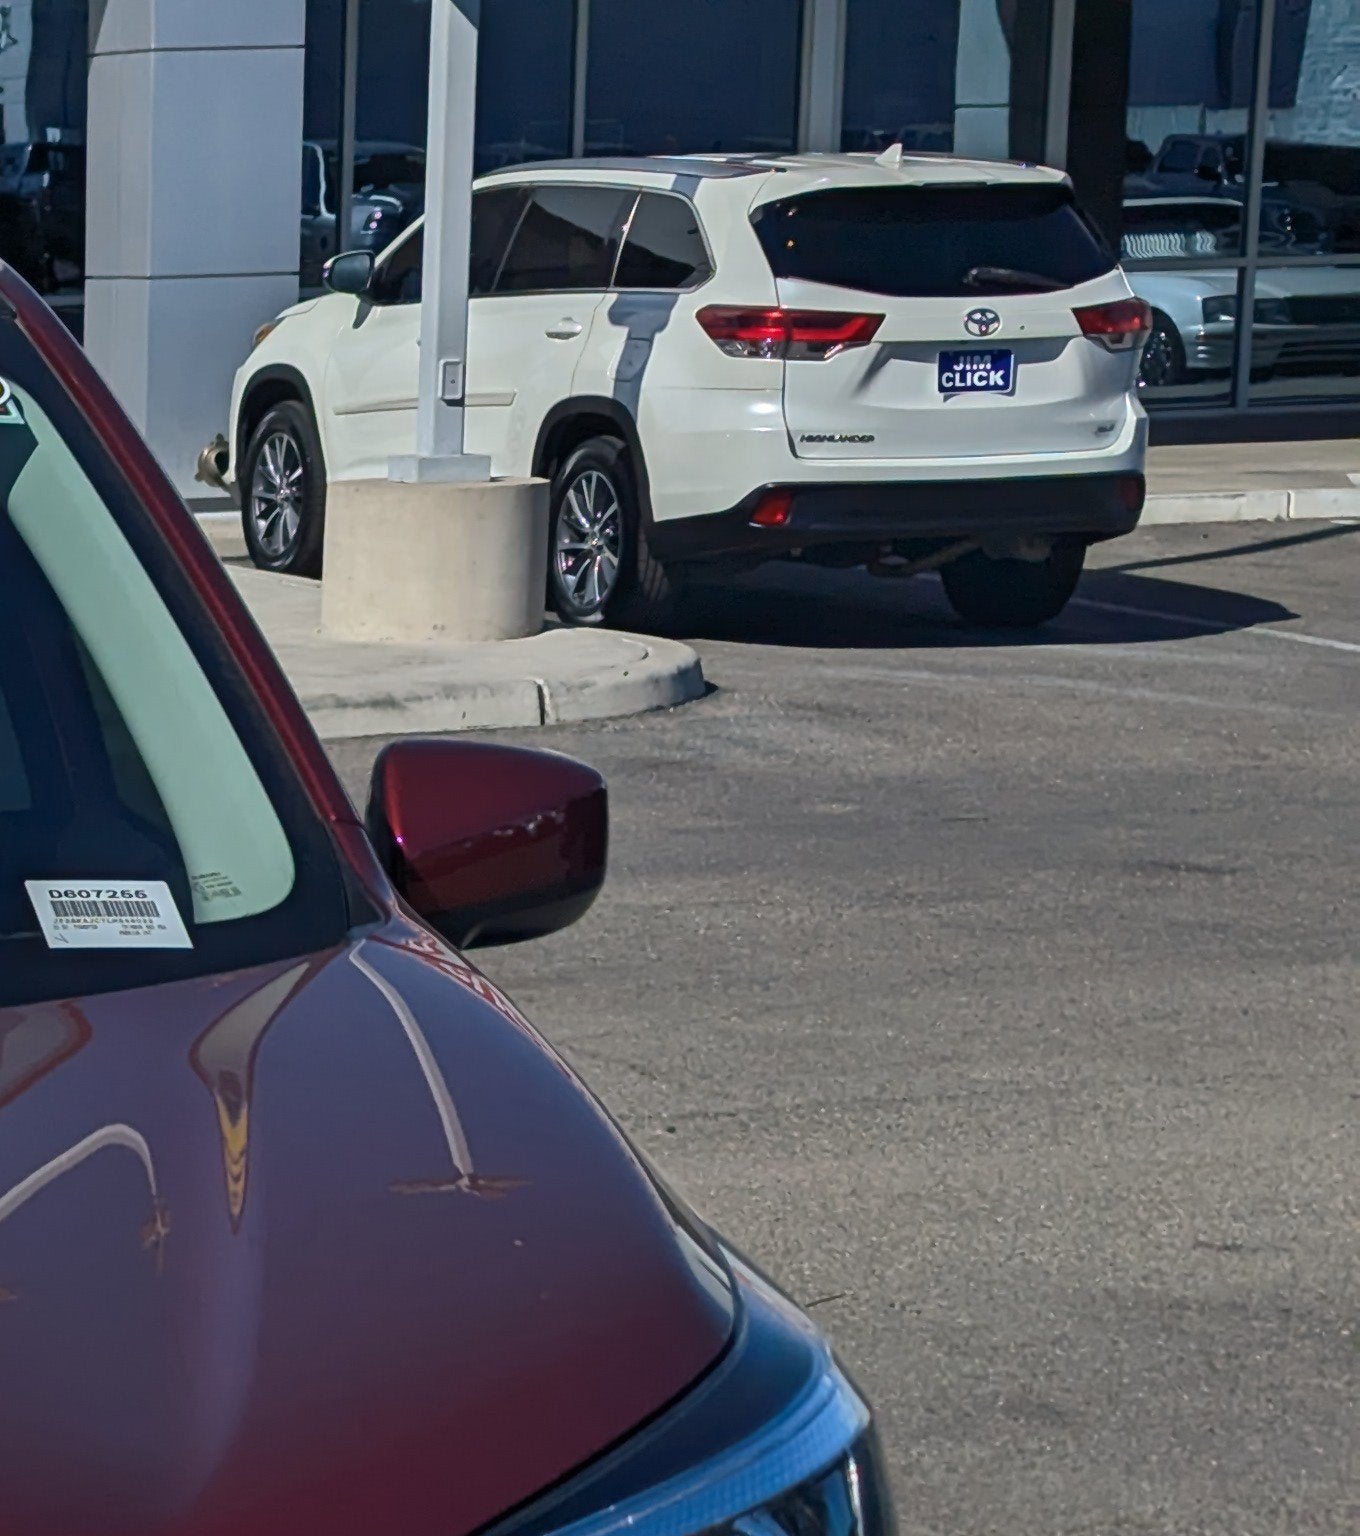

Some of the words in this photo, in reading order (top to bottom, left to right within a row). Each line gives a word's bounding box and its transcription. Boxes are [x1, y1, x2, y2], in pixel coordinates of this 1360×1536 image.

[953, 355, 992, 370] JIM
[941, 370, 1005, 387] CLICK
[48, 889, 148, 899] D607266
